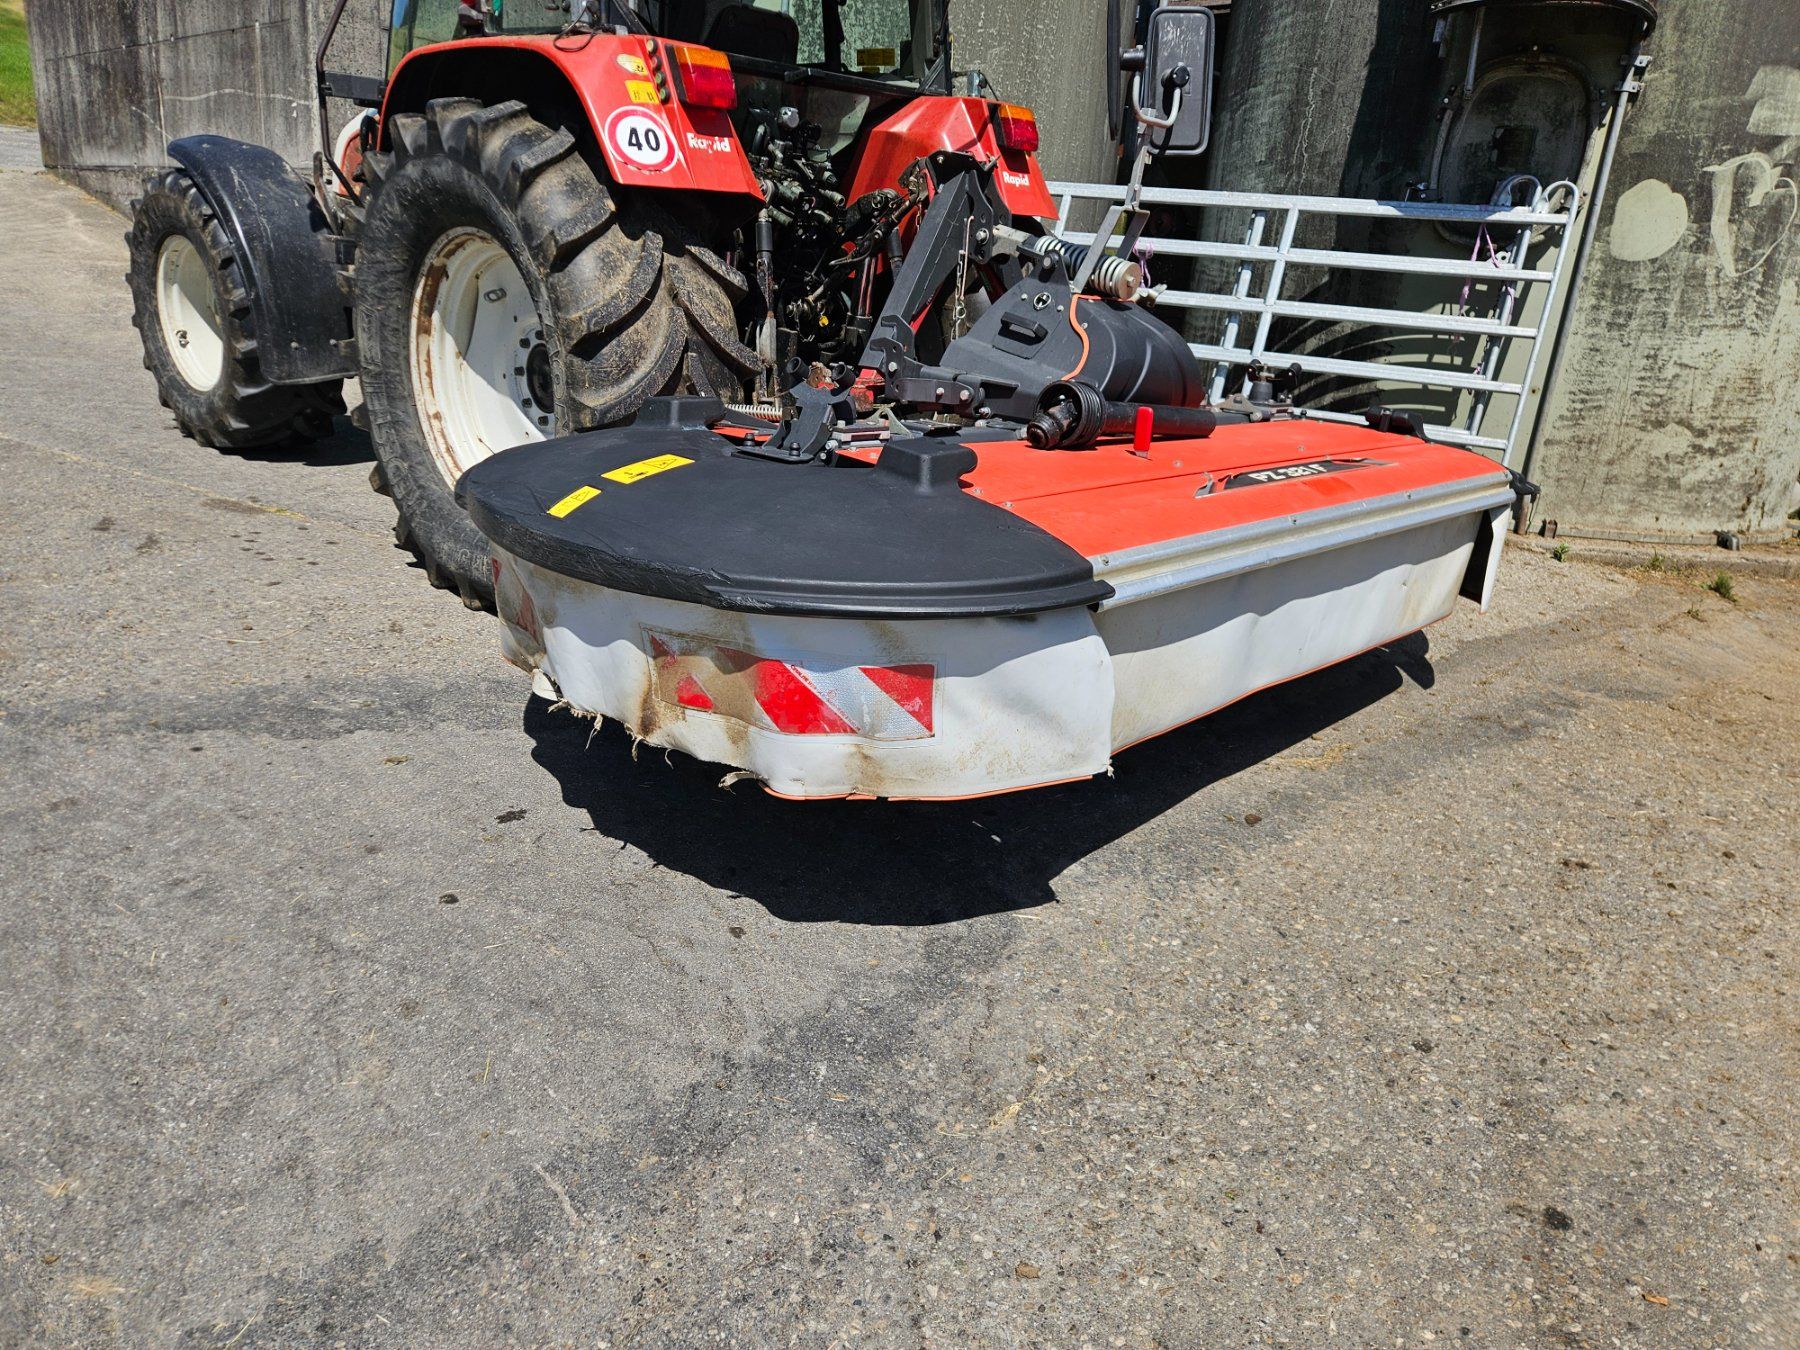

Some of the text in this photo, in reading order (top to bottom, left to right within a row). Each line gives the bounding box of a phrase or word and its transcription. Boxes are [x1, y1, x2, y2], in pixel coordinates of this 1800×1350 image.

[628, 127, 661, 152] 40
[686, 132, 731, 154] Rapid
[1002, 171, 1030, 188] Rapid
[1248, 471, 1286, 482] PZ
